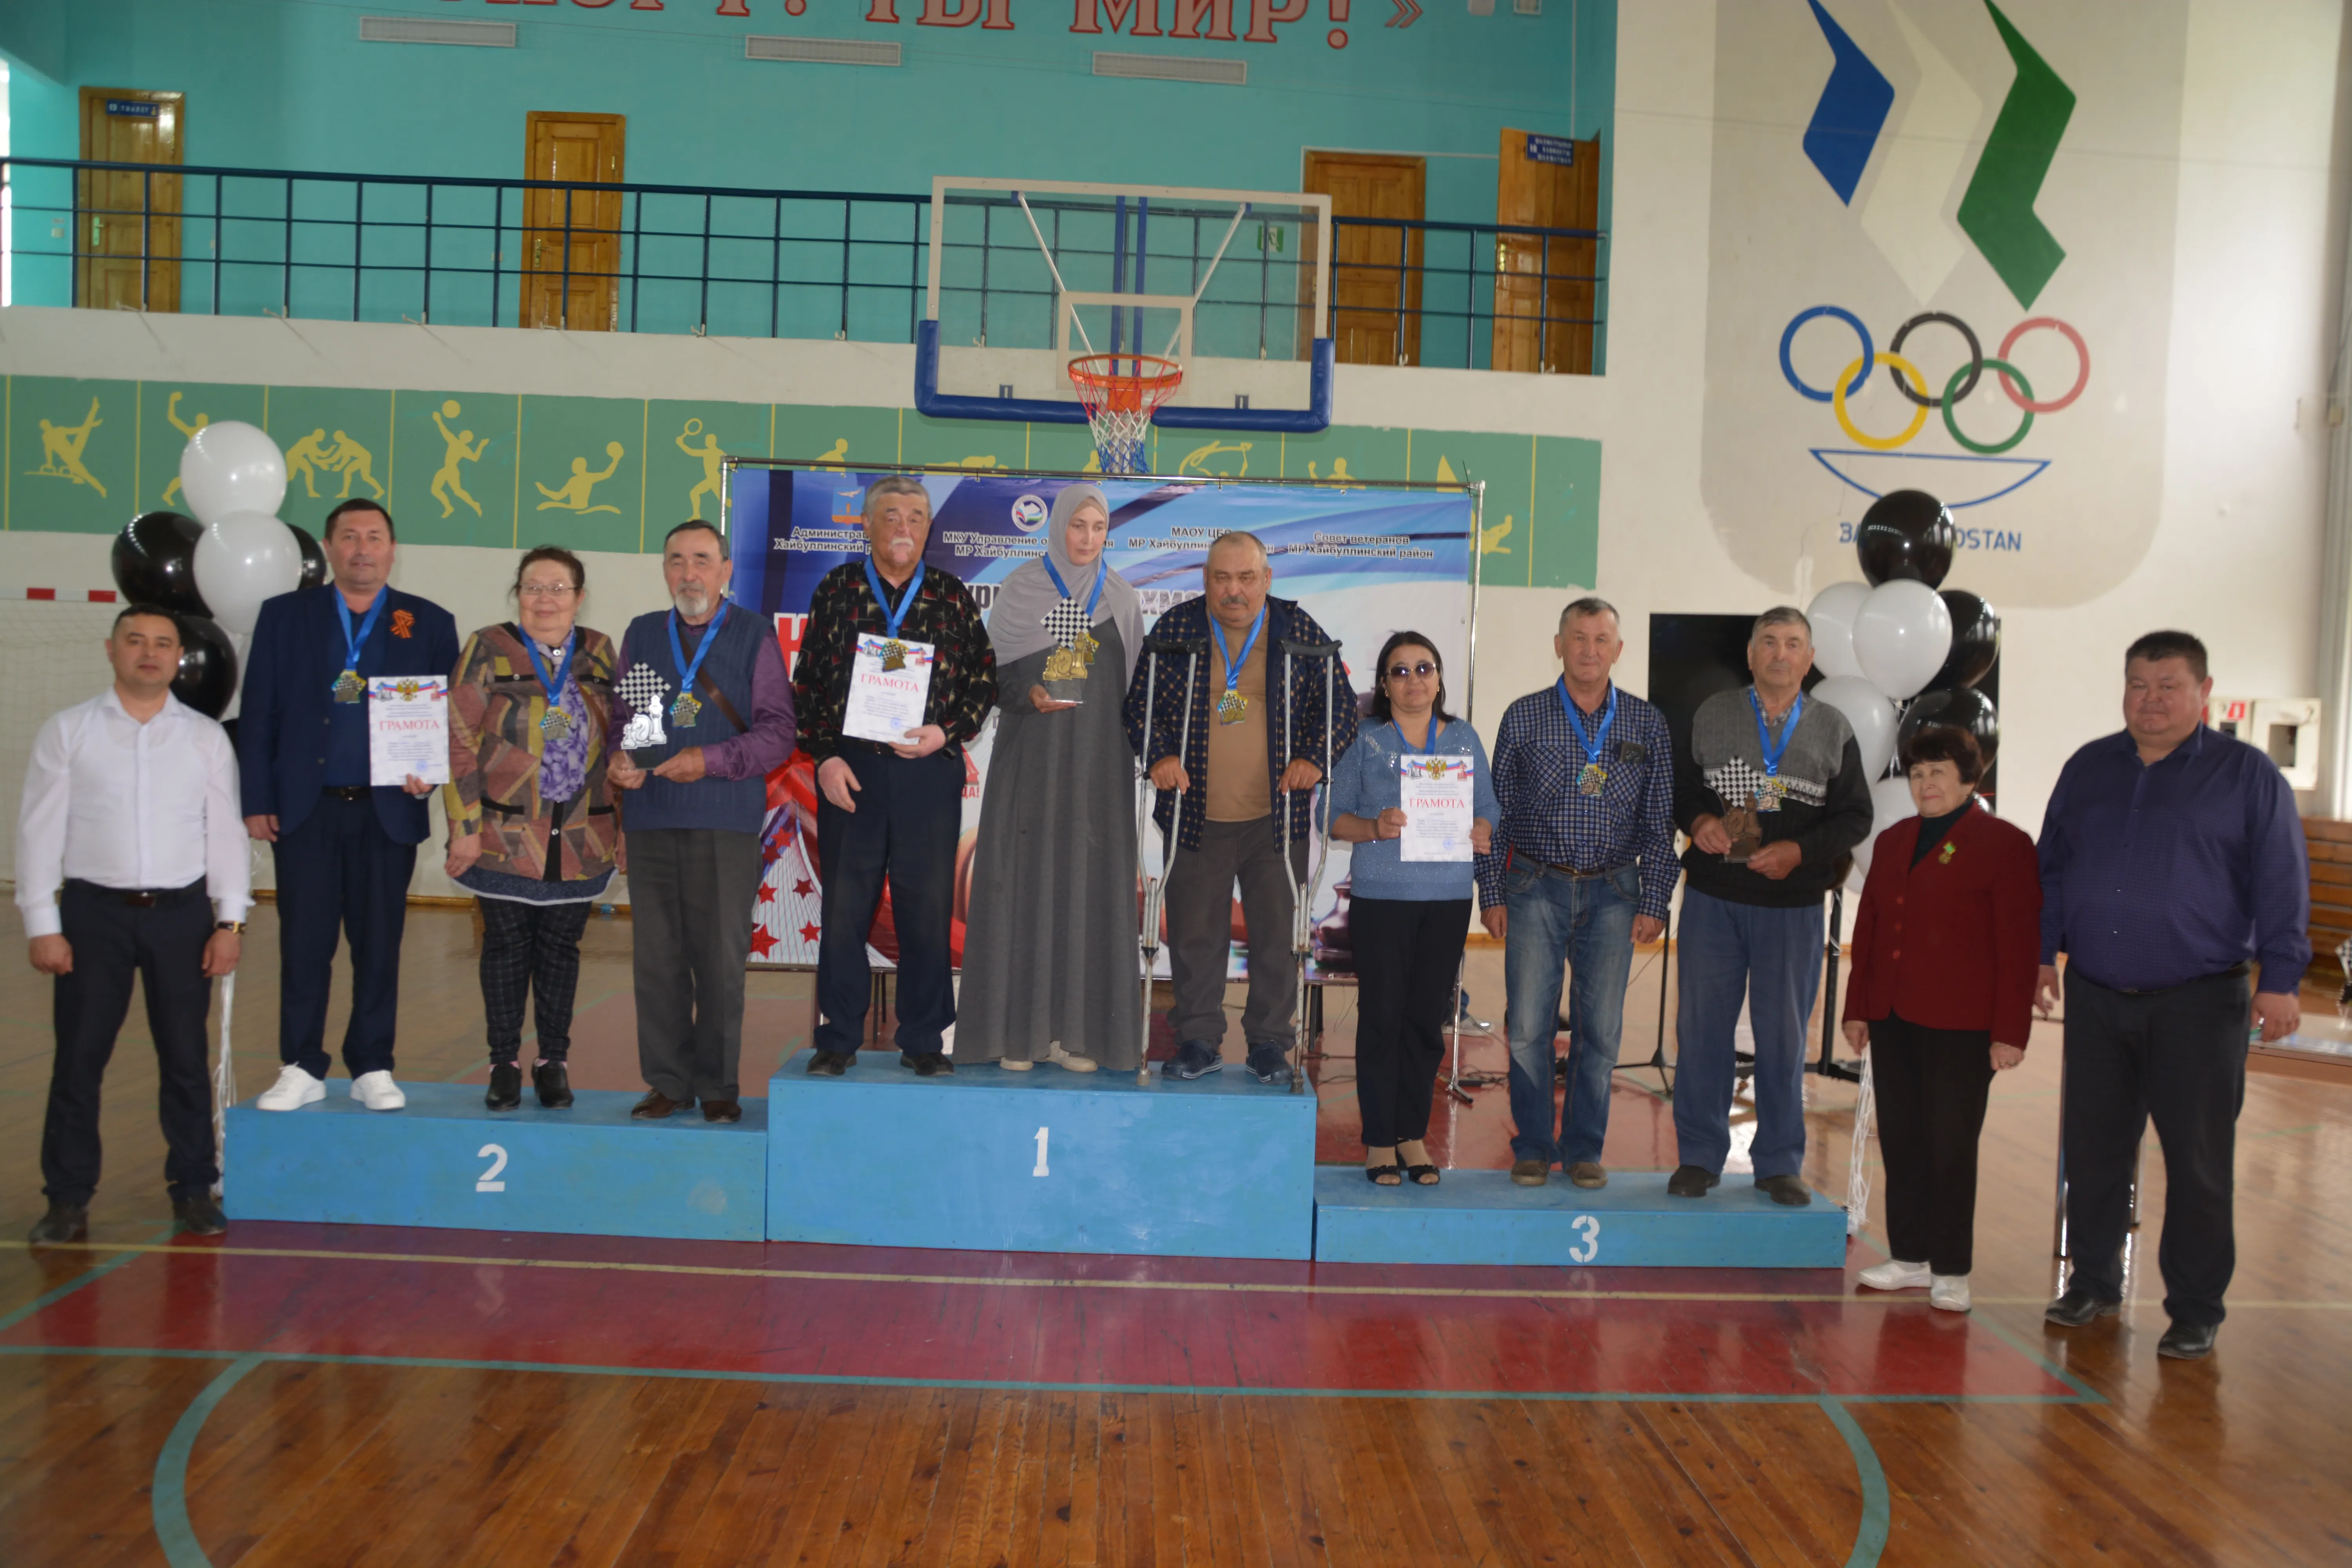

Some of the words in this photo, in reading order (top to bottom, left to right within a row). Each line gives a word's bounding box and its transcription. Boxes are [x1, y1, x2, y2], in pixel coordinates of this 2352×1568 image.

[792, 526, 870, 540] Администрац
[944, 532, 967, 543] МКУ
[969, 532, 1038, 545] Управление
[1171, 527, 1205, 537] МАОУ
[1314, 532, 1348, 543] Совет
[1351, 535, 1409, 546] ветеранов
[775, 539, 864, 552] Хайбуллинский
[1129, 538, 1145, 548] МР
[1148, 539, 1210, 551] Хайбуллин
[956, 545, 973, 556] МР
[975, 546, 1045, 559] Хайбуллинс
[1289, 544, 1306, 554] МР
[1308, 544, 1396, 558] Хайбуллинский
[1399, 548, 1433, 560] район
[861, 674, 919, 692] ГРАМОТА
[379, 720, 440, 731] ГРАМОТА
[1410, 798, 1465, 808] ГРАМОТА
[1033, 1127, 1049, 1176] 1
[476, 1143, 508, 1192] 2
[1569, 1215, 1600, 1263] 3
